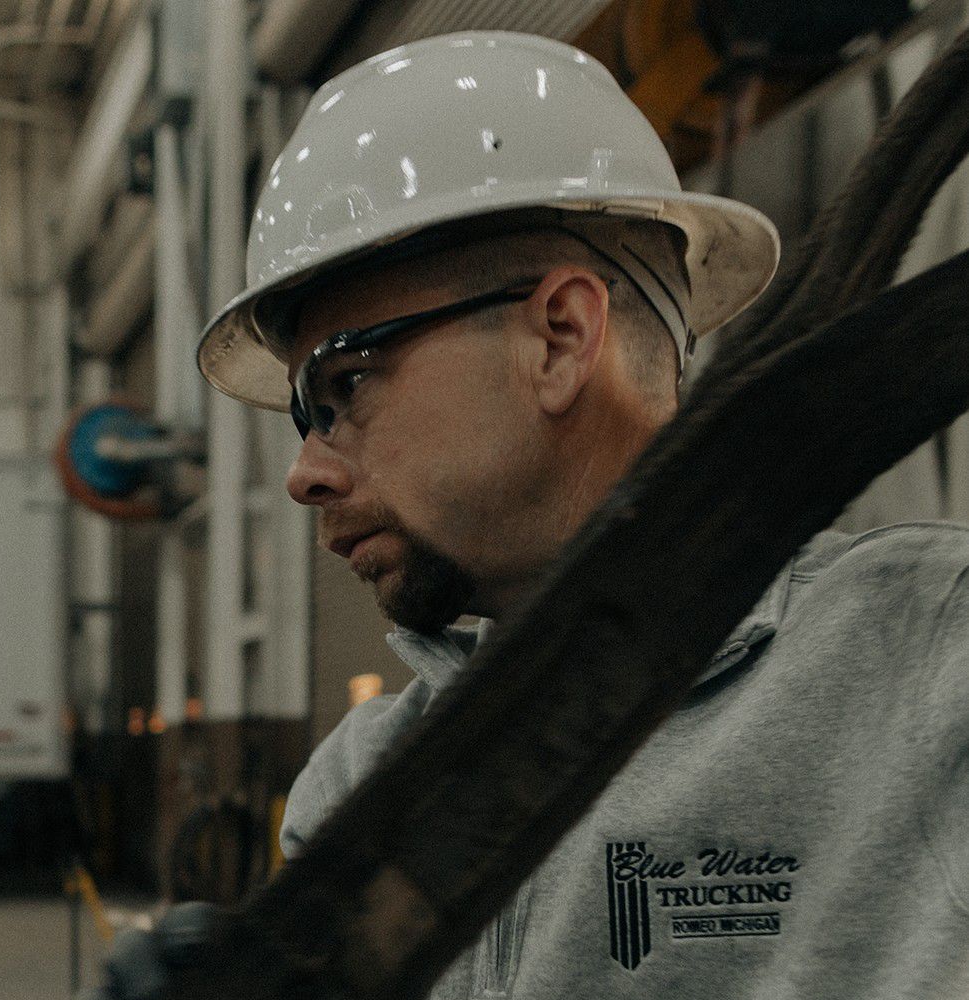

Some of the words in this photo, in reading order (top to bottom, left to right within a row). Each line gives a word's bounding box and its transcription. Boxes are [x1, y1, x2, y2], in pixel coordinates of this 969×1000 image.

[613, 851, 685, 881] Blue
[697, 847, 799, 876] Water
[656, 882, 792, 906] TRUCKING
[672, 919, 716, 934] ROMEO
